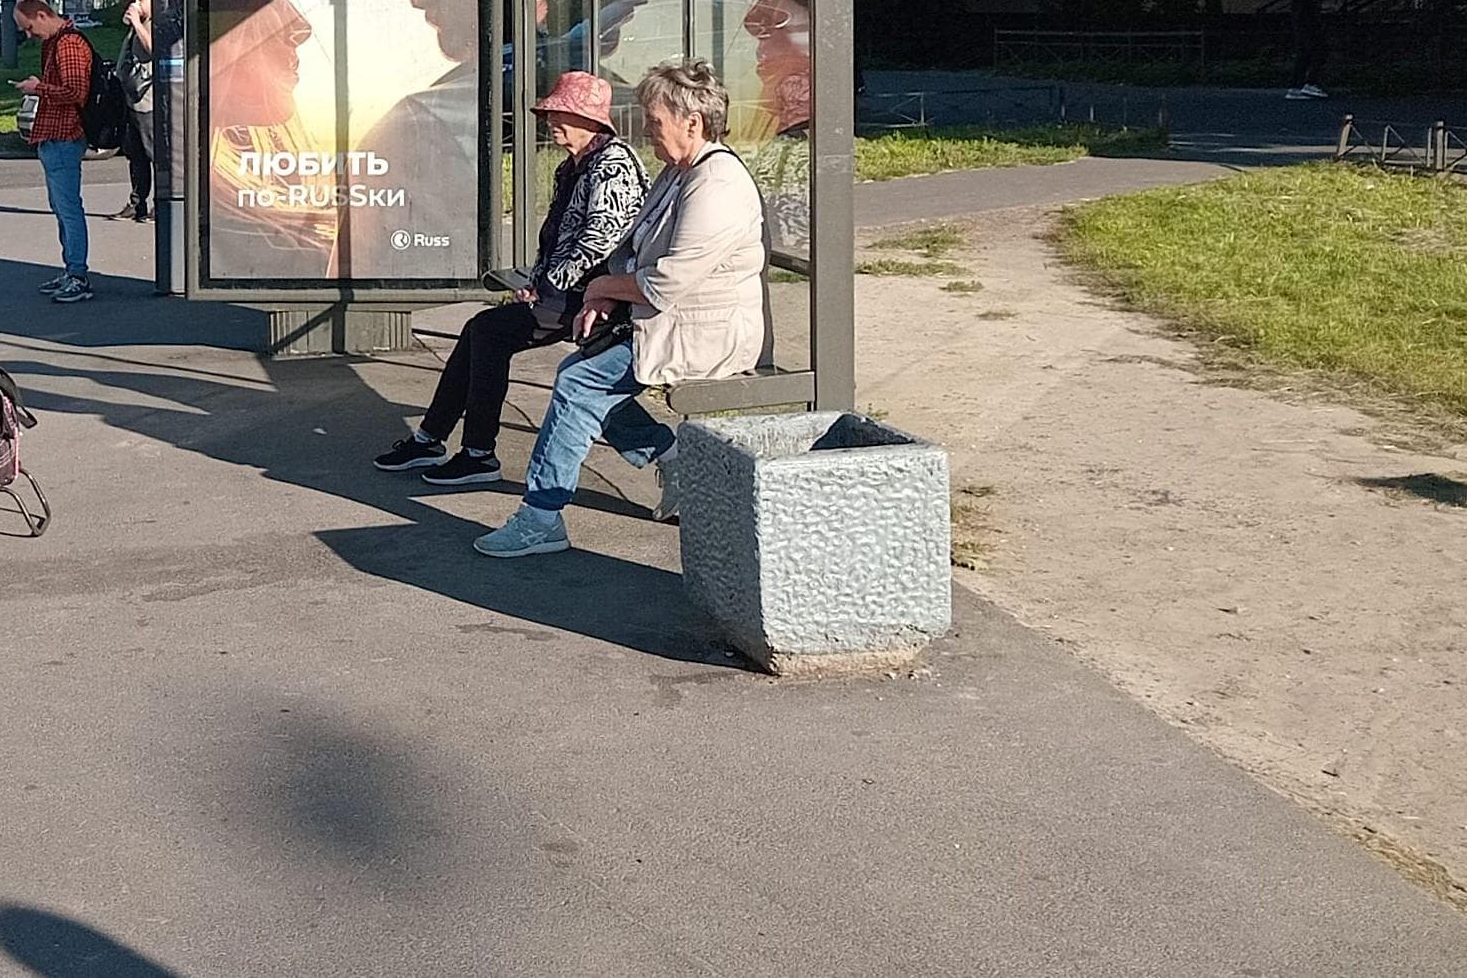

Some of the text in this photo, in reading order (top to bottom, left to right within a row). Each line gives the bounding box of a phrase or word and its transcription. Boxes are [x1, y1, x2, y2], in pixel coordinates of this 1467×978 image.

[238, 151, 390, 176] ЛЮБИТЬ
[237, 184, 406, 208] по-RUSSки
[413, 233, 451, 247] Russ
